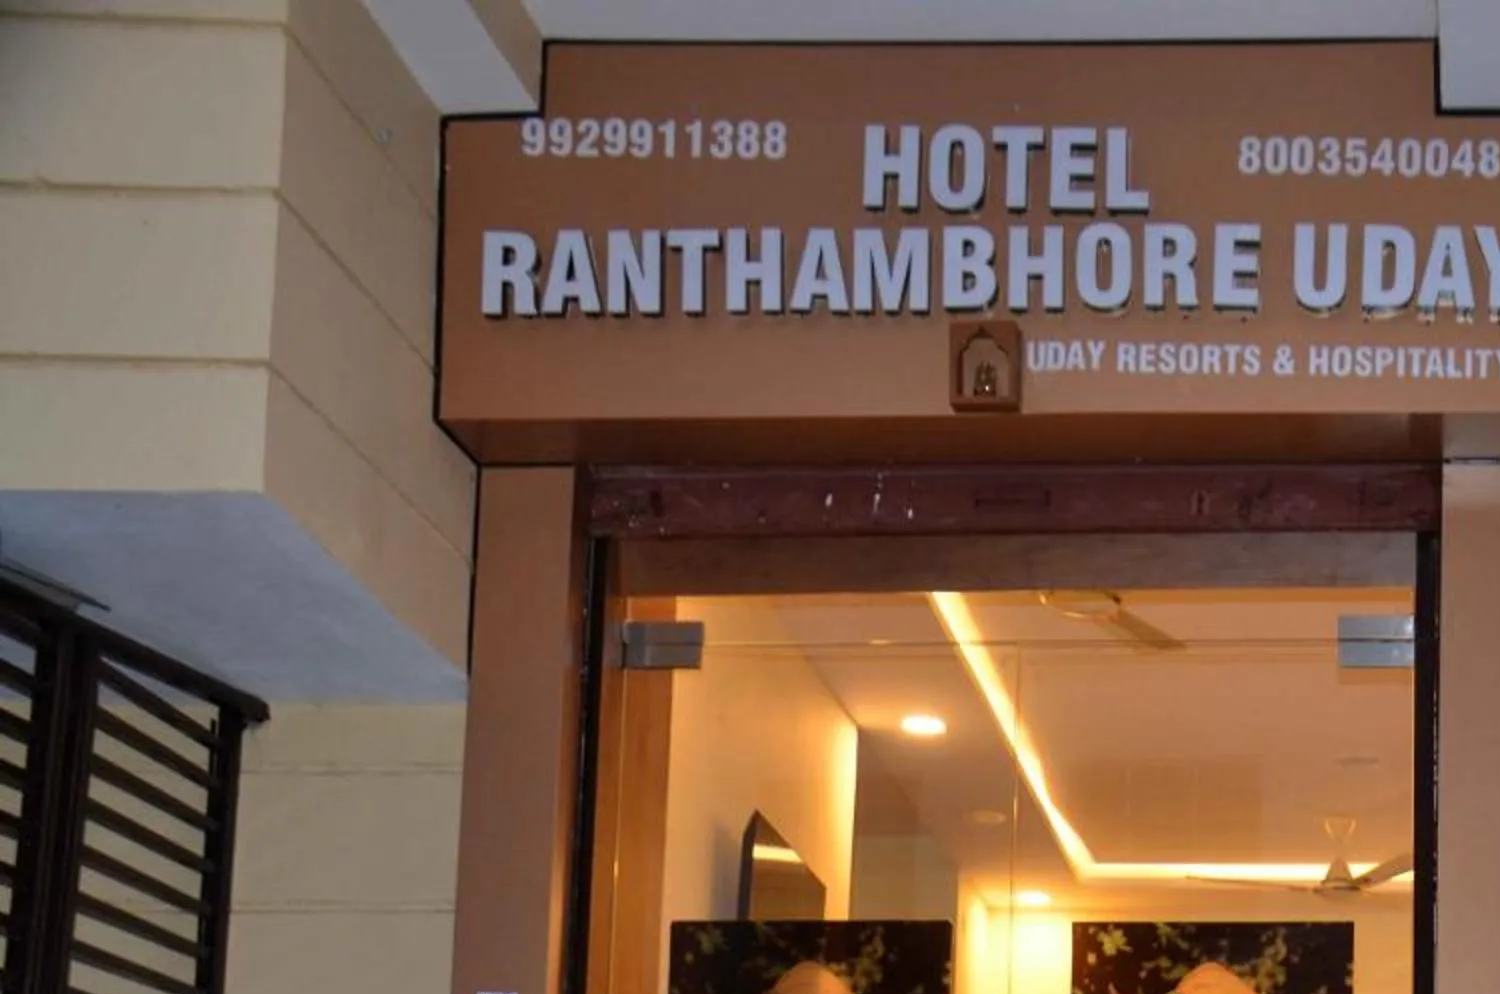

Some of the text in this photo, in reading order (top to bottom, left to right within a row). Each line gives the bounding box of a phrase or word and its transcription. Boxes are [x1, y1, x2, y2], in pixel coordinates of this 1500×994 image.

[521, 117, 787, 160] 9929911388
[1238, 136, 1500, 179] 8003540048
[863, 124, 1150, 214] HOTEL
[481, 222, 1262, 317] RANTHAMBHORE
[1026, 340, 1104, 373] UDAY
[1116, 342, 1260, 376] RESORTS
[1273, 344, 1295, 377] &
